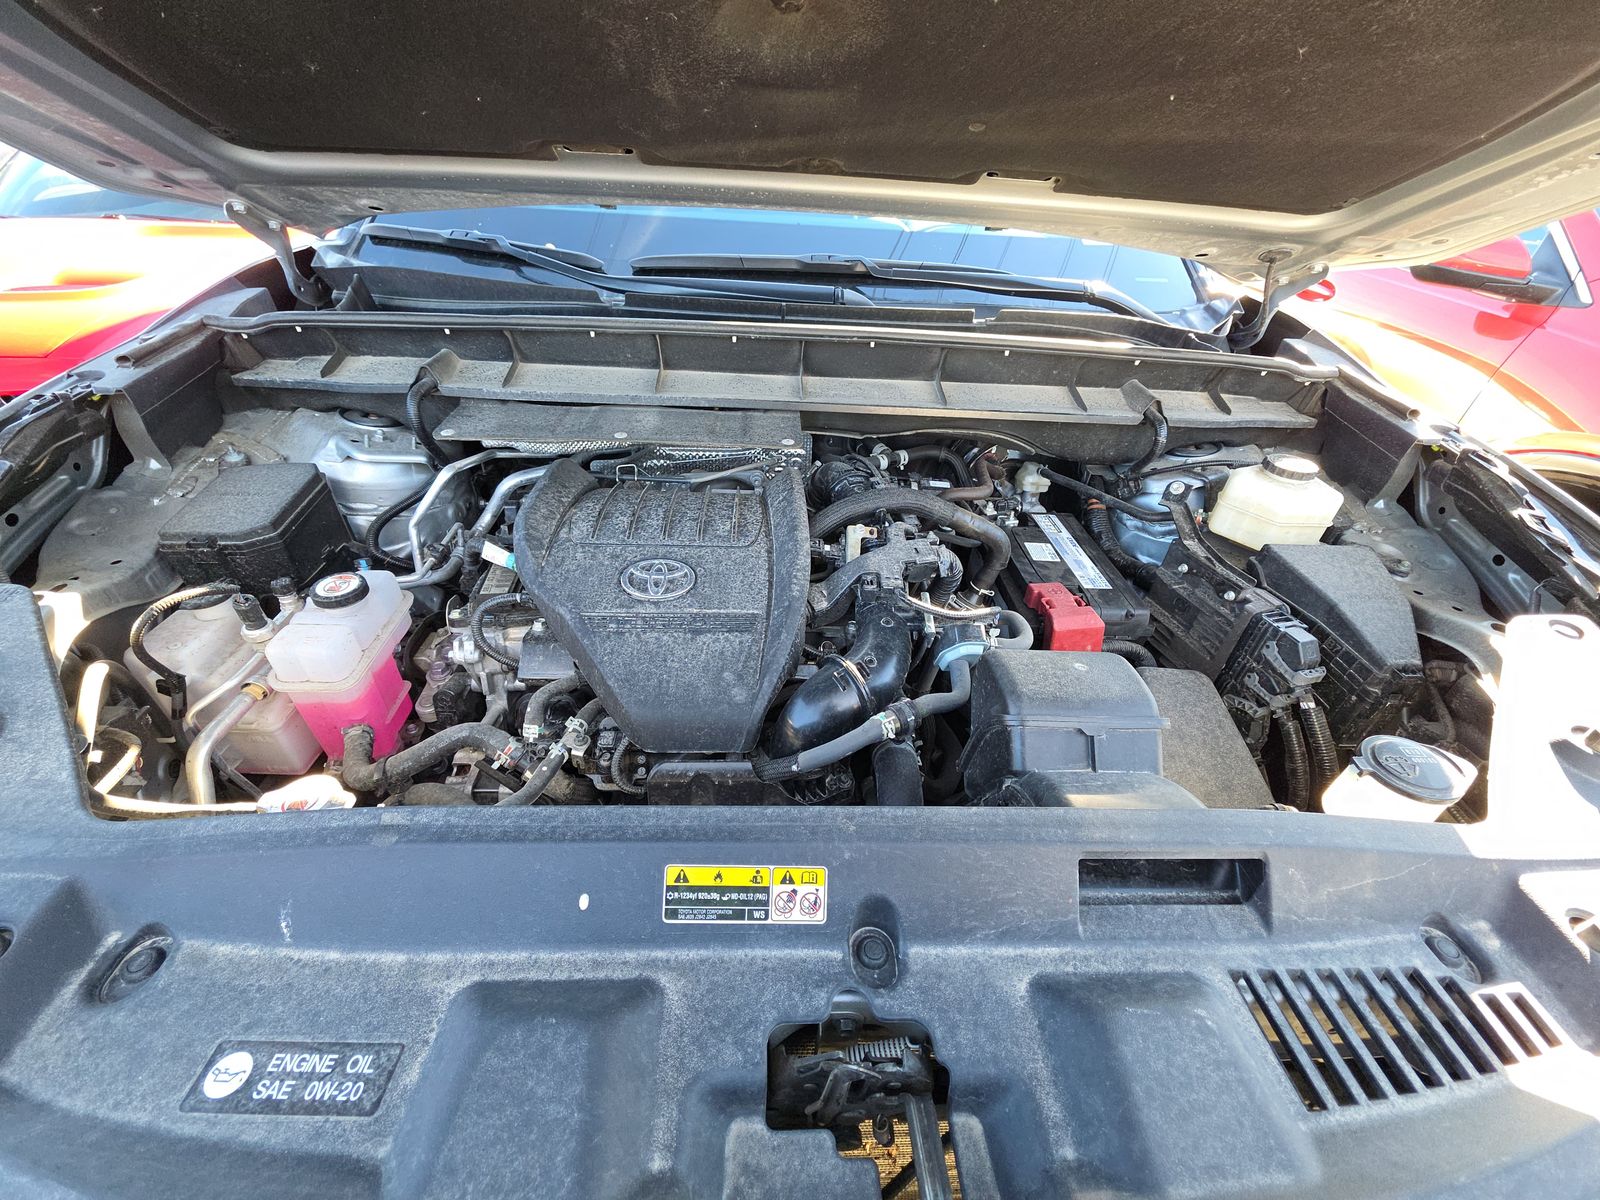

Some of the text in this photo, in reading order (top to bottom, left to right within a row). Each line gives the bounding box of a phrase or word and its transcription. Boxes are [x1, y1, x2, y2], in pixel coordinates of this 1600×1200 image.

[674, 892, 697, 901] R-1234yf
[753, 910, 765, 919] WS
[266, 1053, 374, 1074] ENGINE OIL
[252, 1080, 364, 1102] SAE 0W-20
